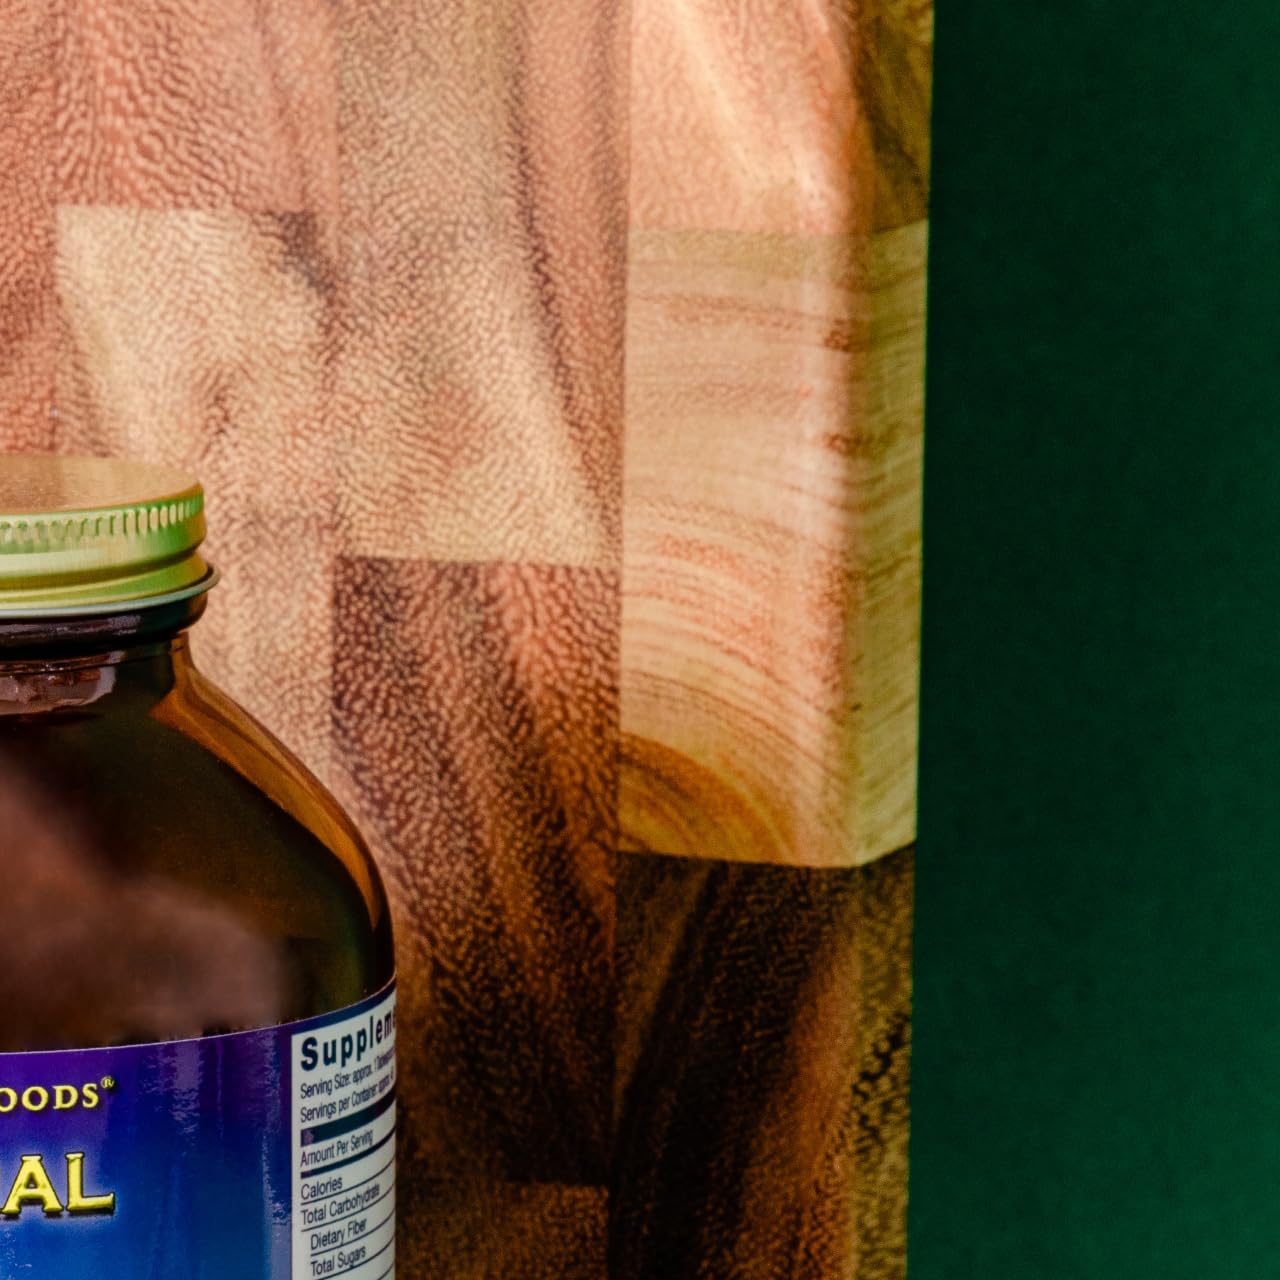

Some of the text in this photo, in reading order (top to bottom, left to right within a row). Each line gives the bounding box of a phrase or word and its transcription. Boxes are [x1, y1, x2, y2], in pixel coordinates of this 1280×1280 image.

[300, 1078, 332, 1099] Serving
[300, 1097, 351, 1123] Servings per
[300, 1129, 373, 1169] Amount Per Serving
[301, 1177, 343, 1200] Calories
[302, 1182, 380, 1225] Total Carbohydrate
[311, 1217, 367, 1250] Dietary Fiber
[311, 1245, 366, 1277] Total Sugars
